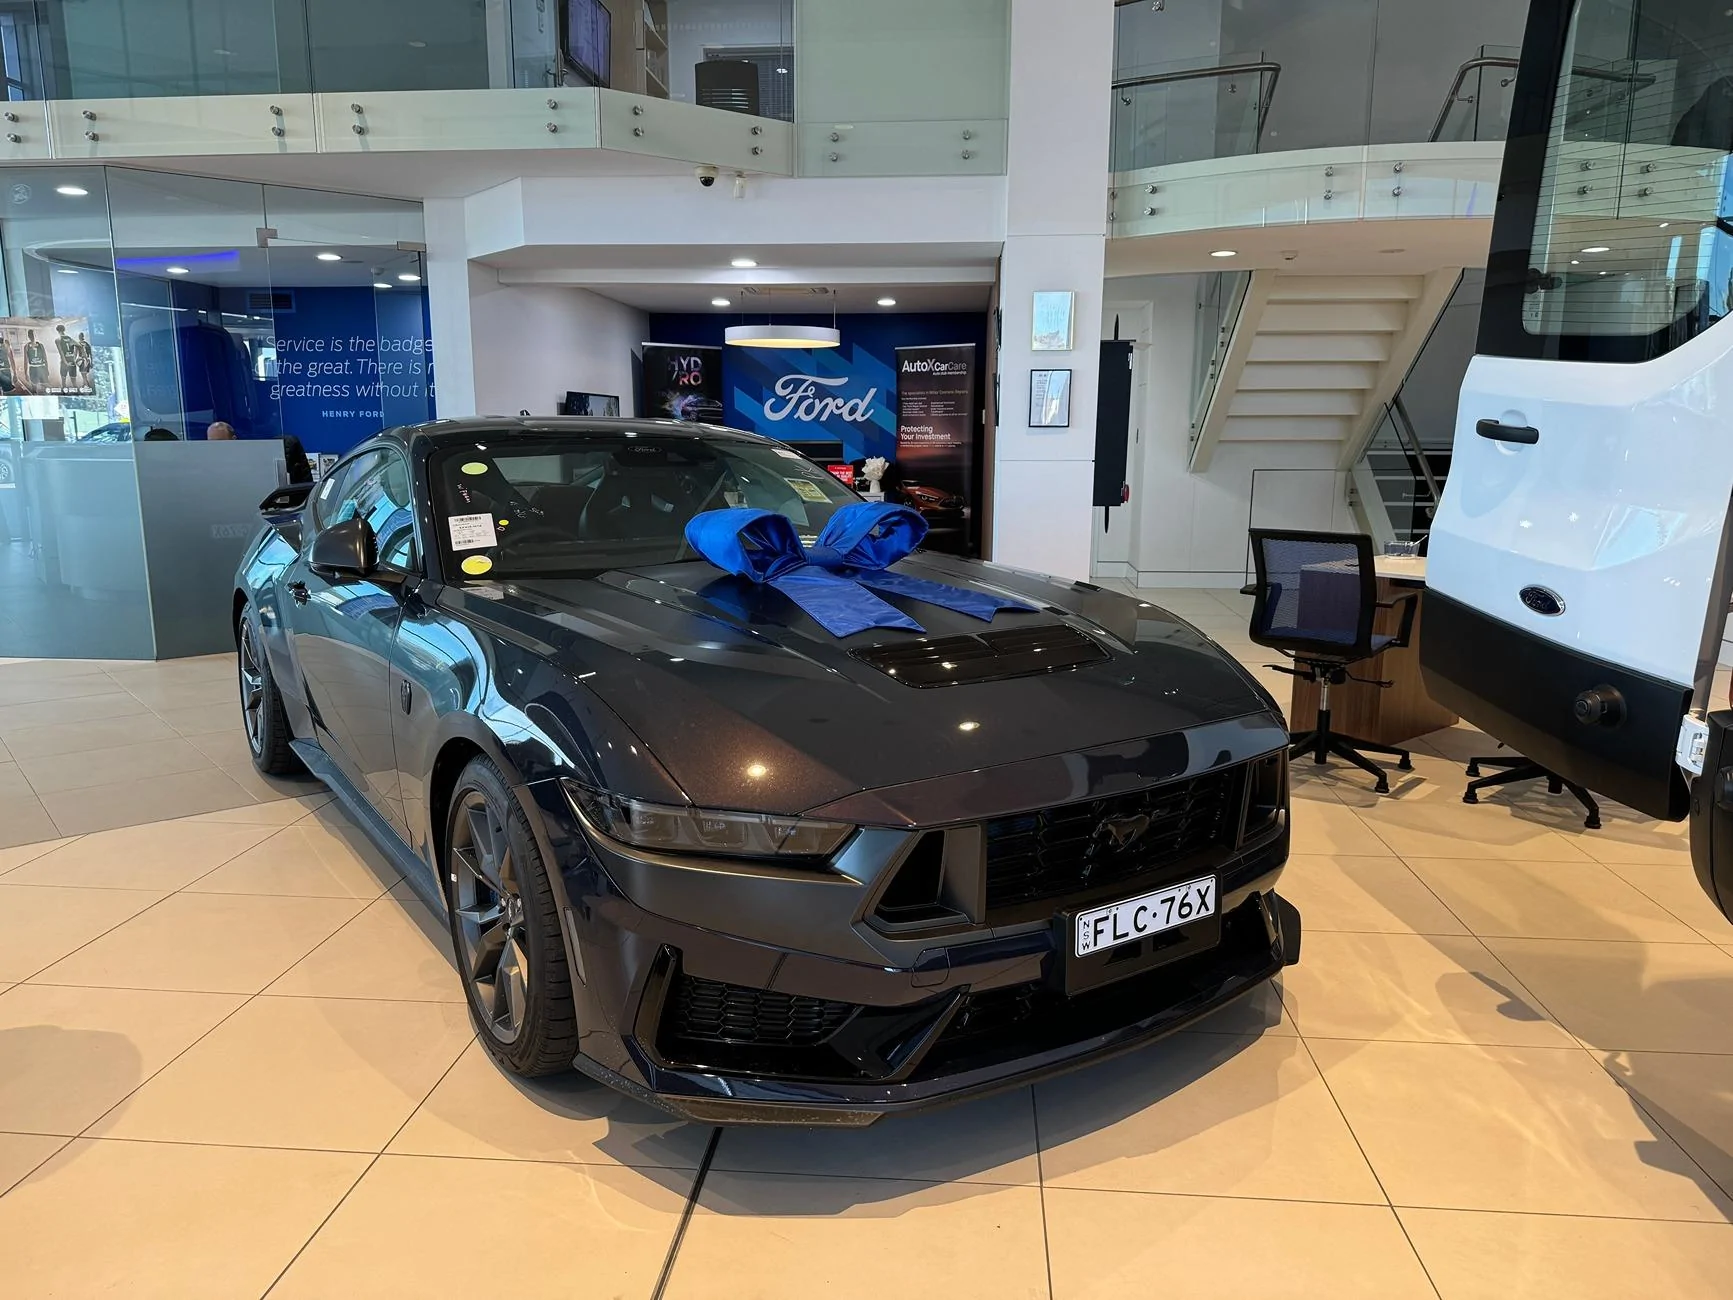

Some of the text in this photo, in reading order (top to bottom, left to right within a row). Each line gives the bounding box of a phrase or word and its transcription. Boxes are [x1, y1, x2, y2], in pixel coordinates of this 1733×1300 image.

[330, 336, 343, 352] is
[349, 336, 375, 352] the
[380, 336, 433, 355] badge
[277, 358, 303, 375] the
[307, 359, 353, 377] great.
[356, 358, 403, 375] There
[408, 359, 422, 375] is
[269, 381, 350, 400] greatness
[356, 381, 419, 398] without
[763, 374, 878, 422] Ford
[322, 410, 385, 418] HENRY FORD
[900, 425, 933, 434] Protecting
